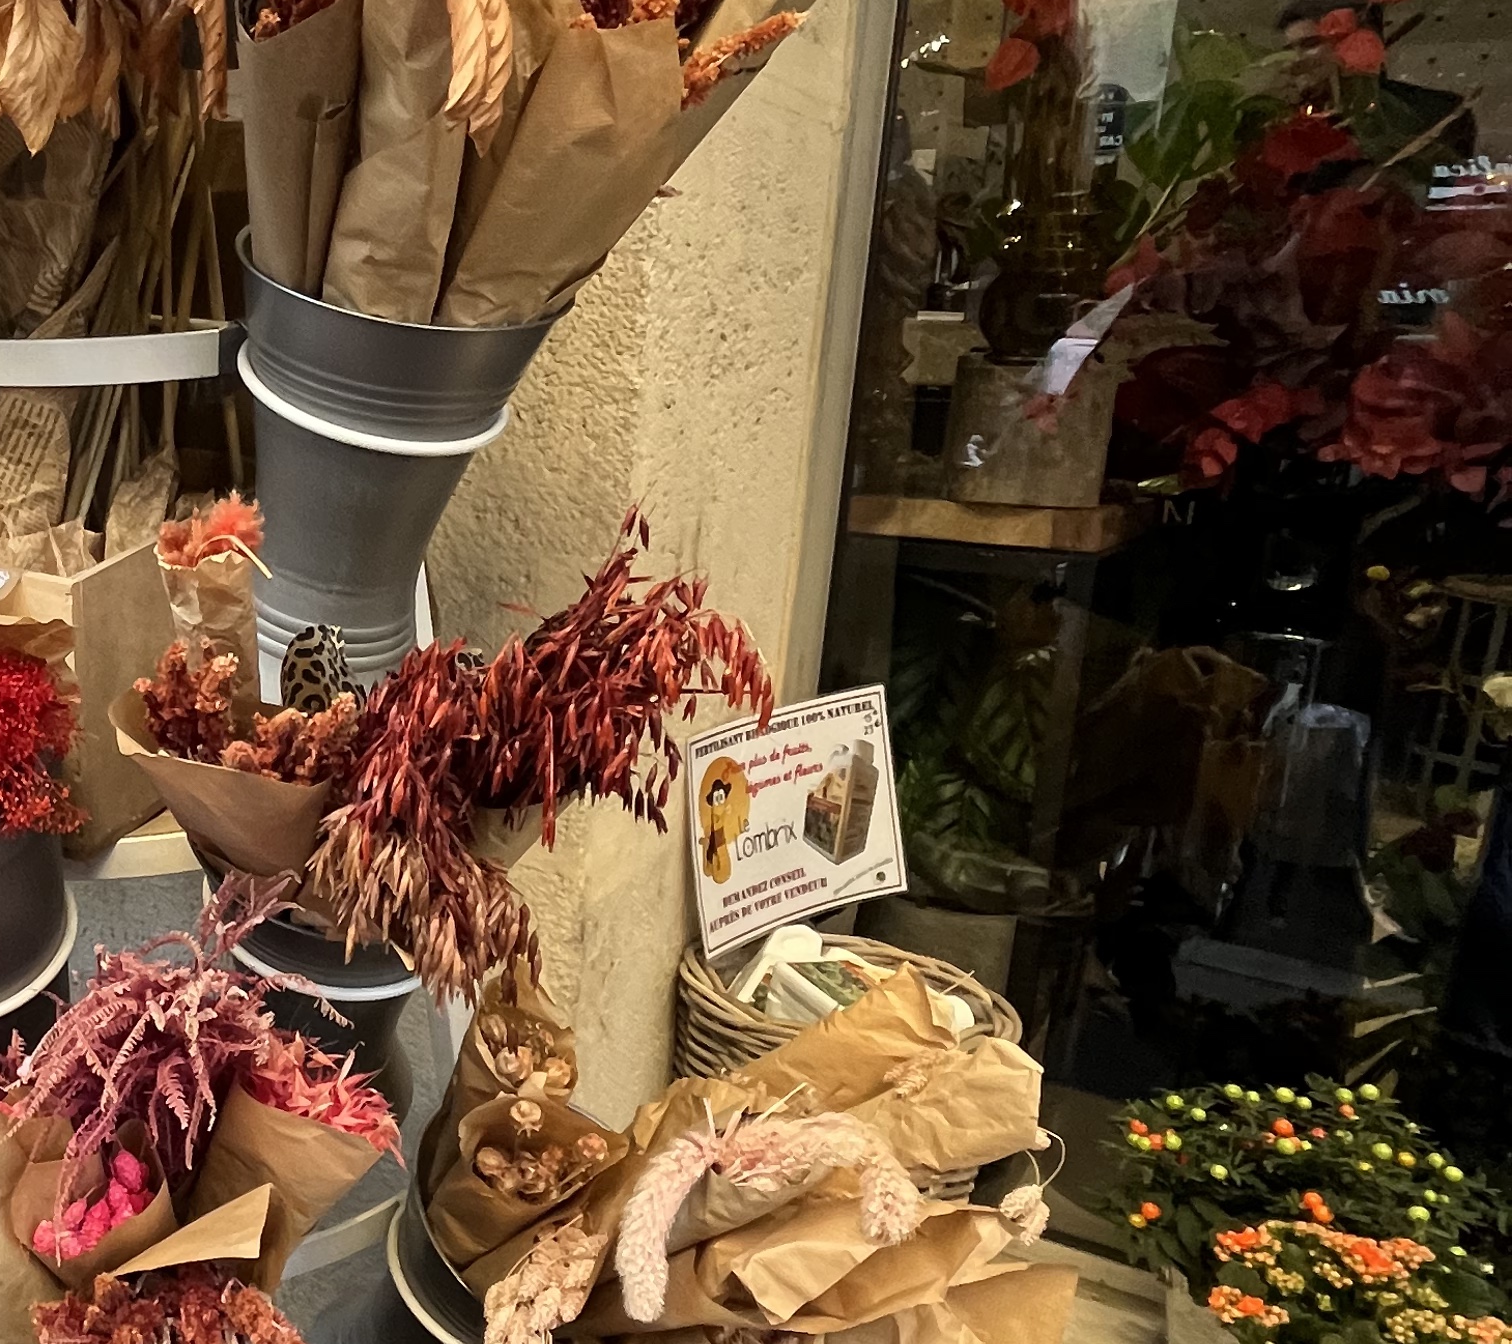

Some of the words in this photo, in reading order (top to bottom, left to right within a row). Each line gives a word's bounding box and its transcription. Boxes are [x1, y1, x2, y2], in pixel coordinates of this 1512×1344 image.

[695, 732, 743, 759] FERTILISANT
[801, 711, 825, 726] 100%
[827, 700, 875, 719] NATUREL
[748, 752, 767, 775] plus
[769, 747, 780, 762] de
[783, 769, 792, 782] et
[722, 880, 768, 908] DEMANDEZ
[769, 867, 806, 889] CONSEIL
[741, 904, 753, 918] DE
[754, 892, 782, 912] VOTRE
